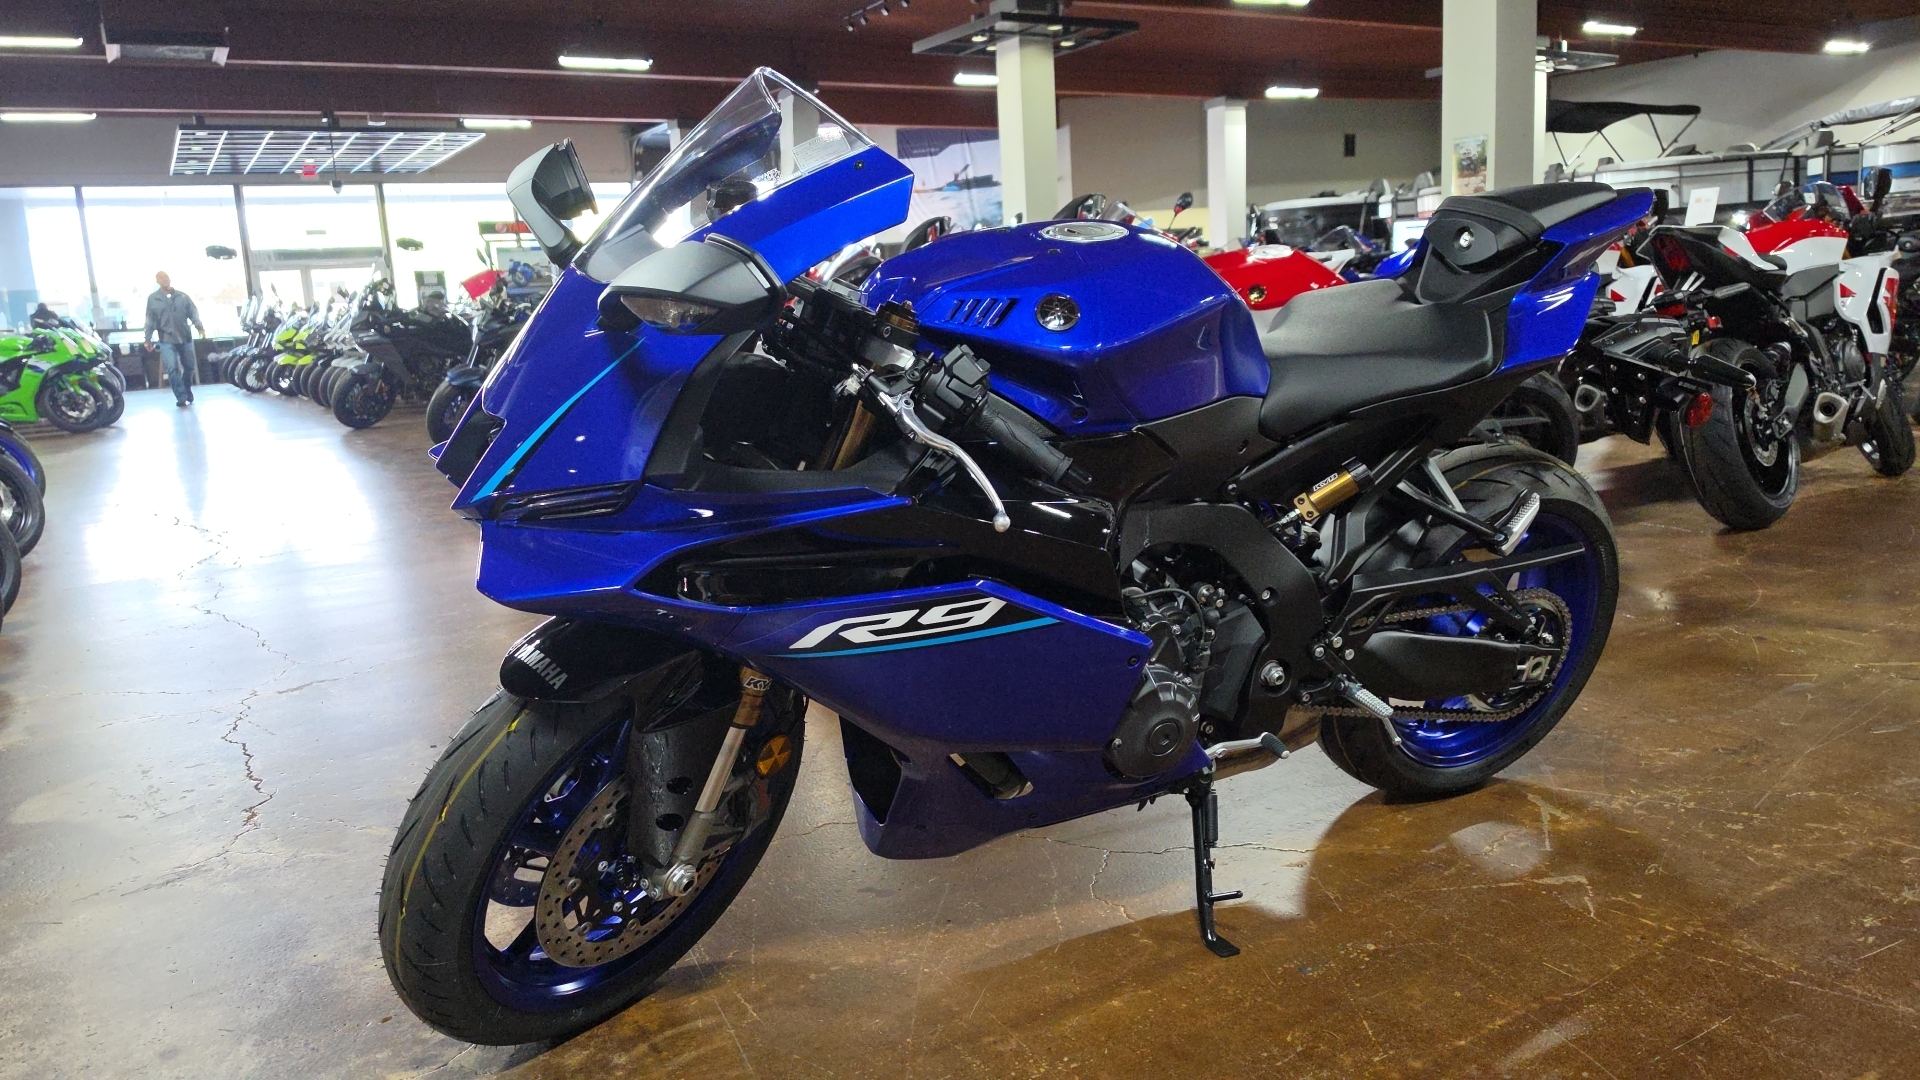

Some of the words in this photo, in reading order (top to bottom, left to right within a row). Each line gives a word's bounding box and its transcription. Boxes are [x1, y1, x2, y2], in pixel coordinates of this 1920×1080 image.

[789, 597, 1006, 649] R9
[514, 643, 568, 690] YAMAHA
[743, 676, 773, 690] KY
